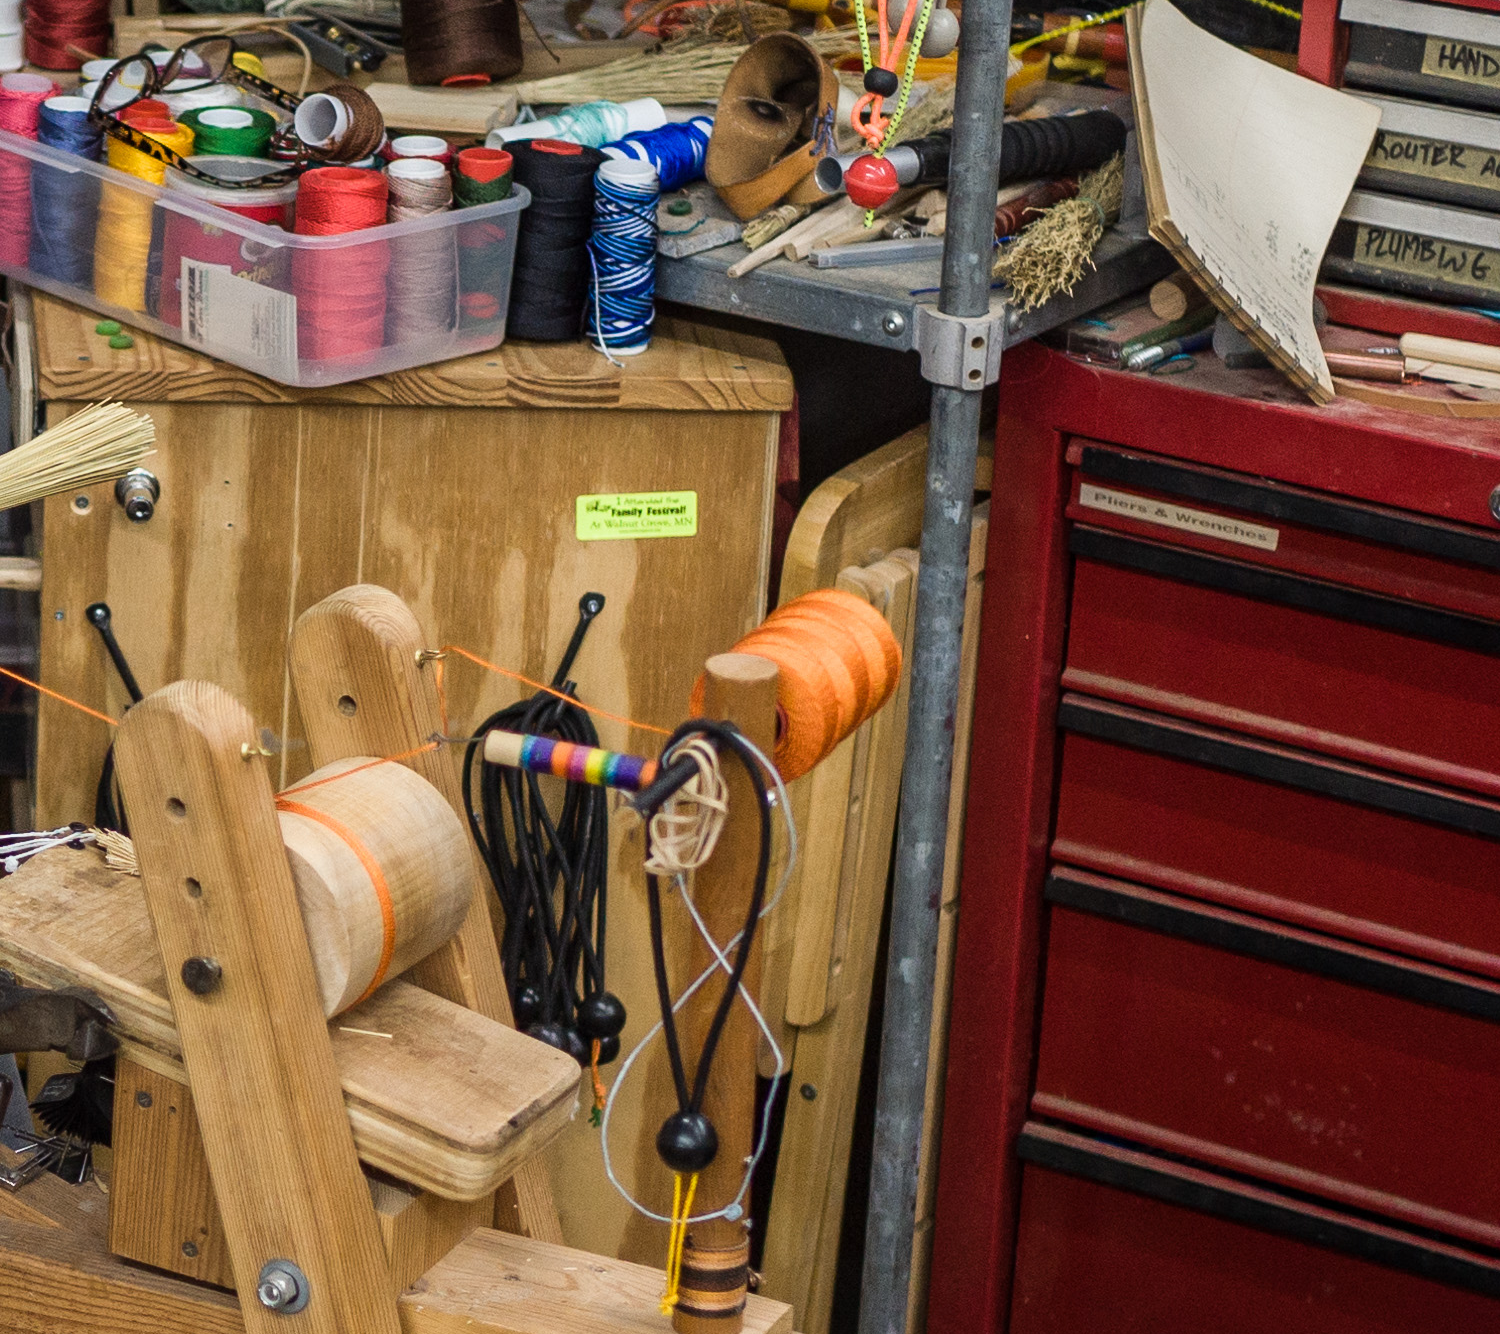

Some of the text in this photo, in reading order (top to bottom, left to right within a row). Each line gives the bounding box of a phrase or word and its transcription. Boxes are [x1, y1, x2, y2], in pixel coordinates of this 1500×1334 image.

[1438, 44, 1500, 78] HAND
[1372, 132, 1466, 168] ROUTER
[1364, 229, 1491, 281] PLUMBING
[611, 507, 643, 517] Family
[674, 517, 692, 526] MN
[1094, 491, 1267, 542] Pliers & Wrenches
